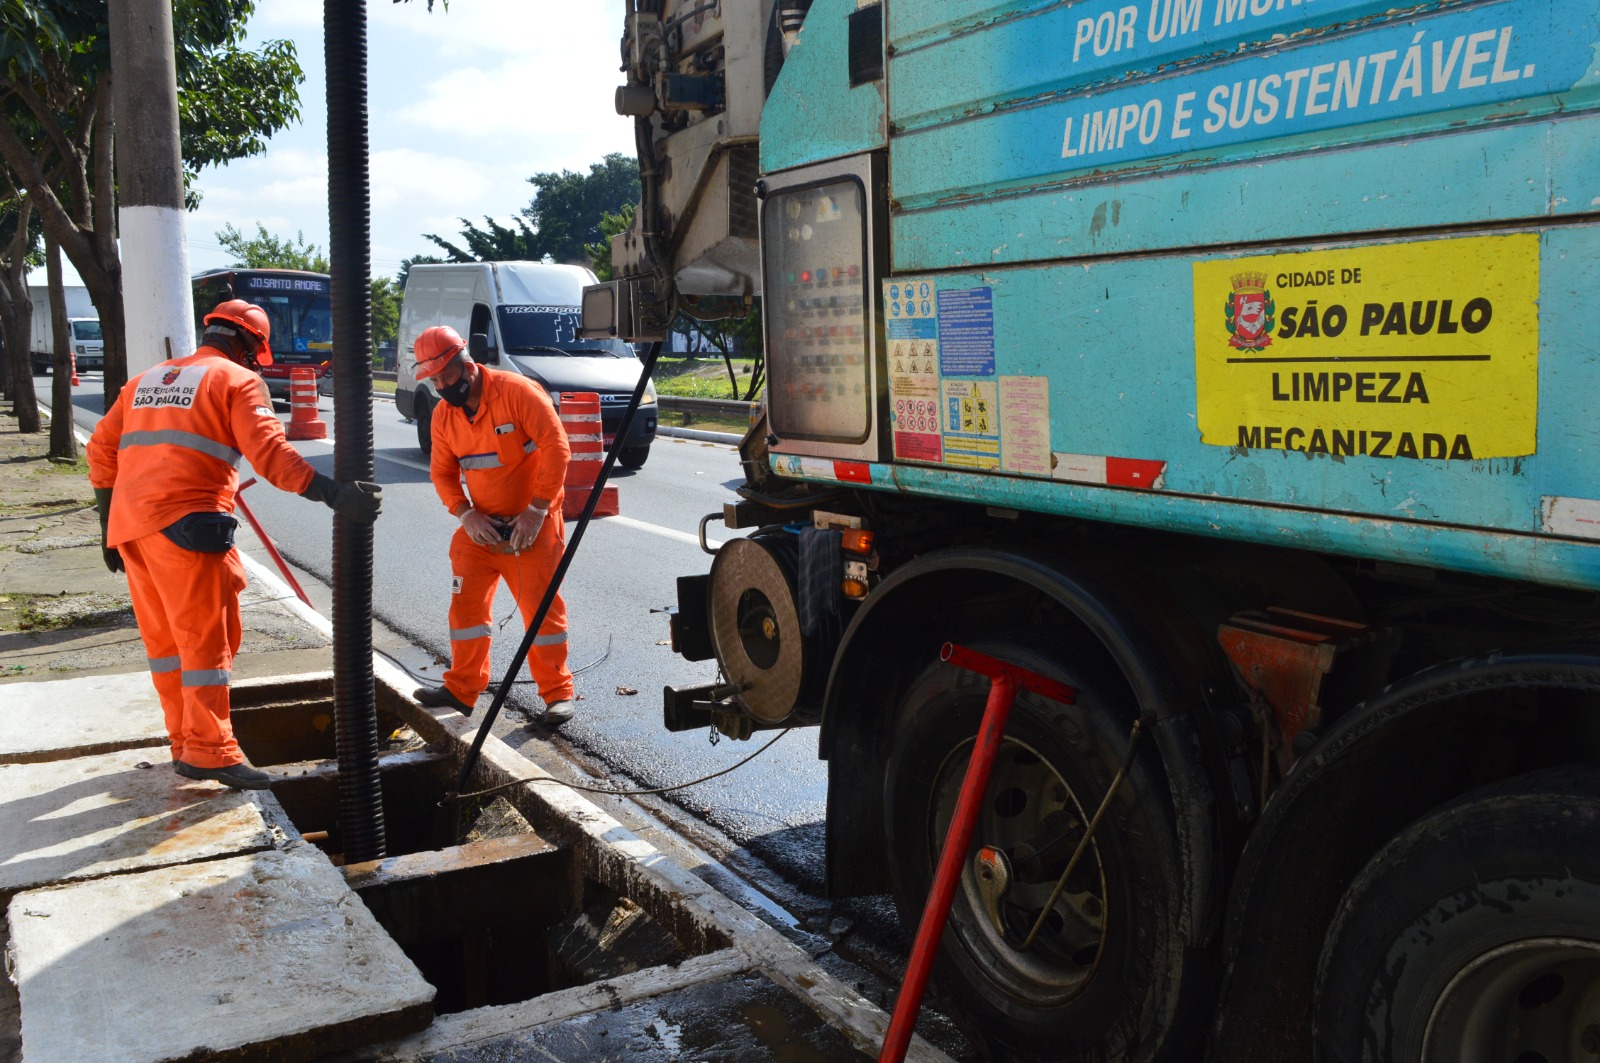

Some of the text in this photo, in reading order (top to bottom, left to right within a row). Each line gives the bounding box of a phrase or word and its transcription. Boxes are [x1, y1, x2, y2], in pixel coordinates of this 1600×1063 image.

[1073, 5, 1138, 63] POR
[1147, 0, 1202, 43] UM
[1061, 26, 1536, 158] LIMPO E SUSTENTÁVEL.
[1276, 268, 1361, 288] CIDADE DE
[1278, 297, 1493, 339] SÃO PAULO
[134, 394, 192, 407] SÃO PAULO
[137, 386, 195, 395] PREFEITURA DE
[1272, 372, 1429, 403] LIMPEZA
[1238, 425, 1474, 460] MECANIZADA
